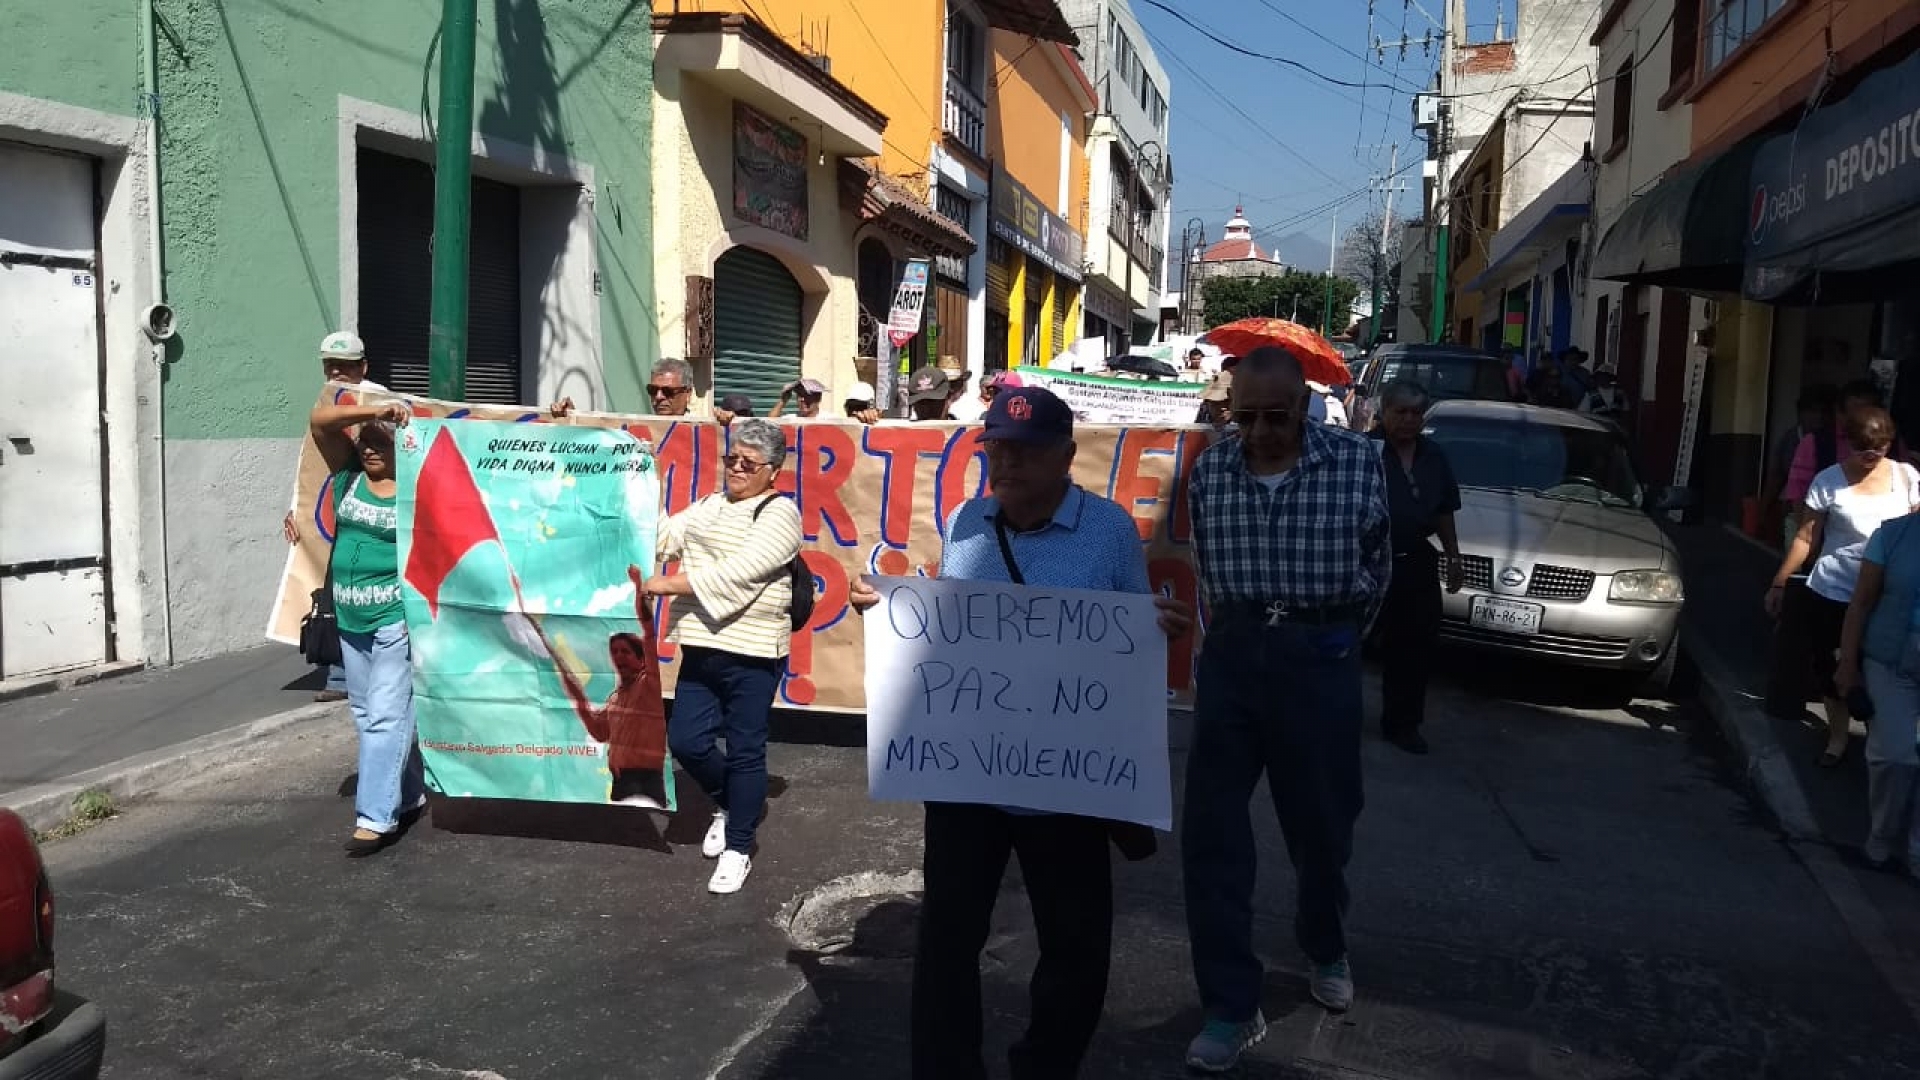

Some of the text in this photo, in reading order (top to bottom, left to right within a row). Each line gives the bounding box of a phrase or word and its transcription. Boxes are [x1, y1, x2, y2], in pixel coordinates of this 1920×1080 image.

[1768, 173, 1807, 230] pepsi
[74, 275, 91, 286] 65
[488, 438, 544, 453] QUIENES
[549, 440, 598, 454] LUCHAN
[476, 458, 508, 471] VIDA
[512, 459, 555, 472] DIGNA
[564, 461, 607, 474] NUNCA
[889, 585, 1134, 654] QUEREMOS
[1474, 605, 1537, 627] PXN-86-21
[913, 661, 1108, 714] PAZ. NO
[424, 739, 466, 751] Gustavo
[467, 742, 512, 755] Salgado
[515, 744, 563, 756] Delgado
[885, 735, 960, 771] MAS
